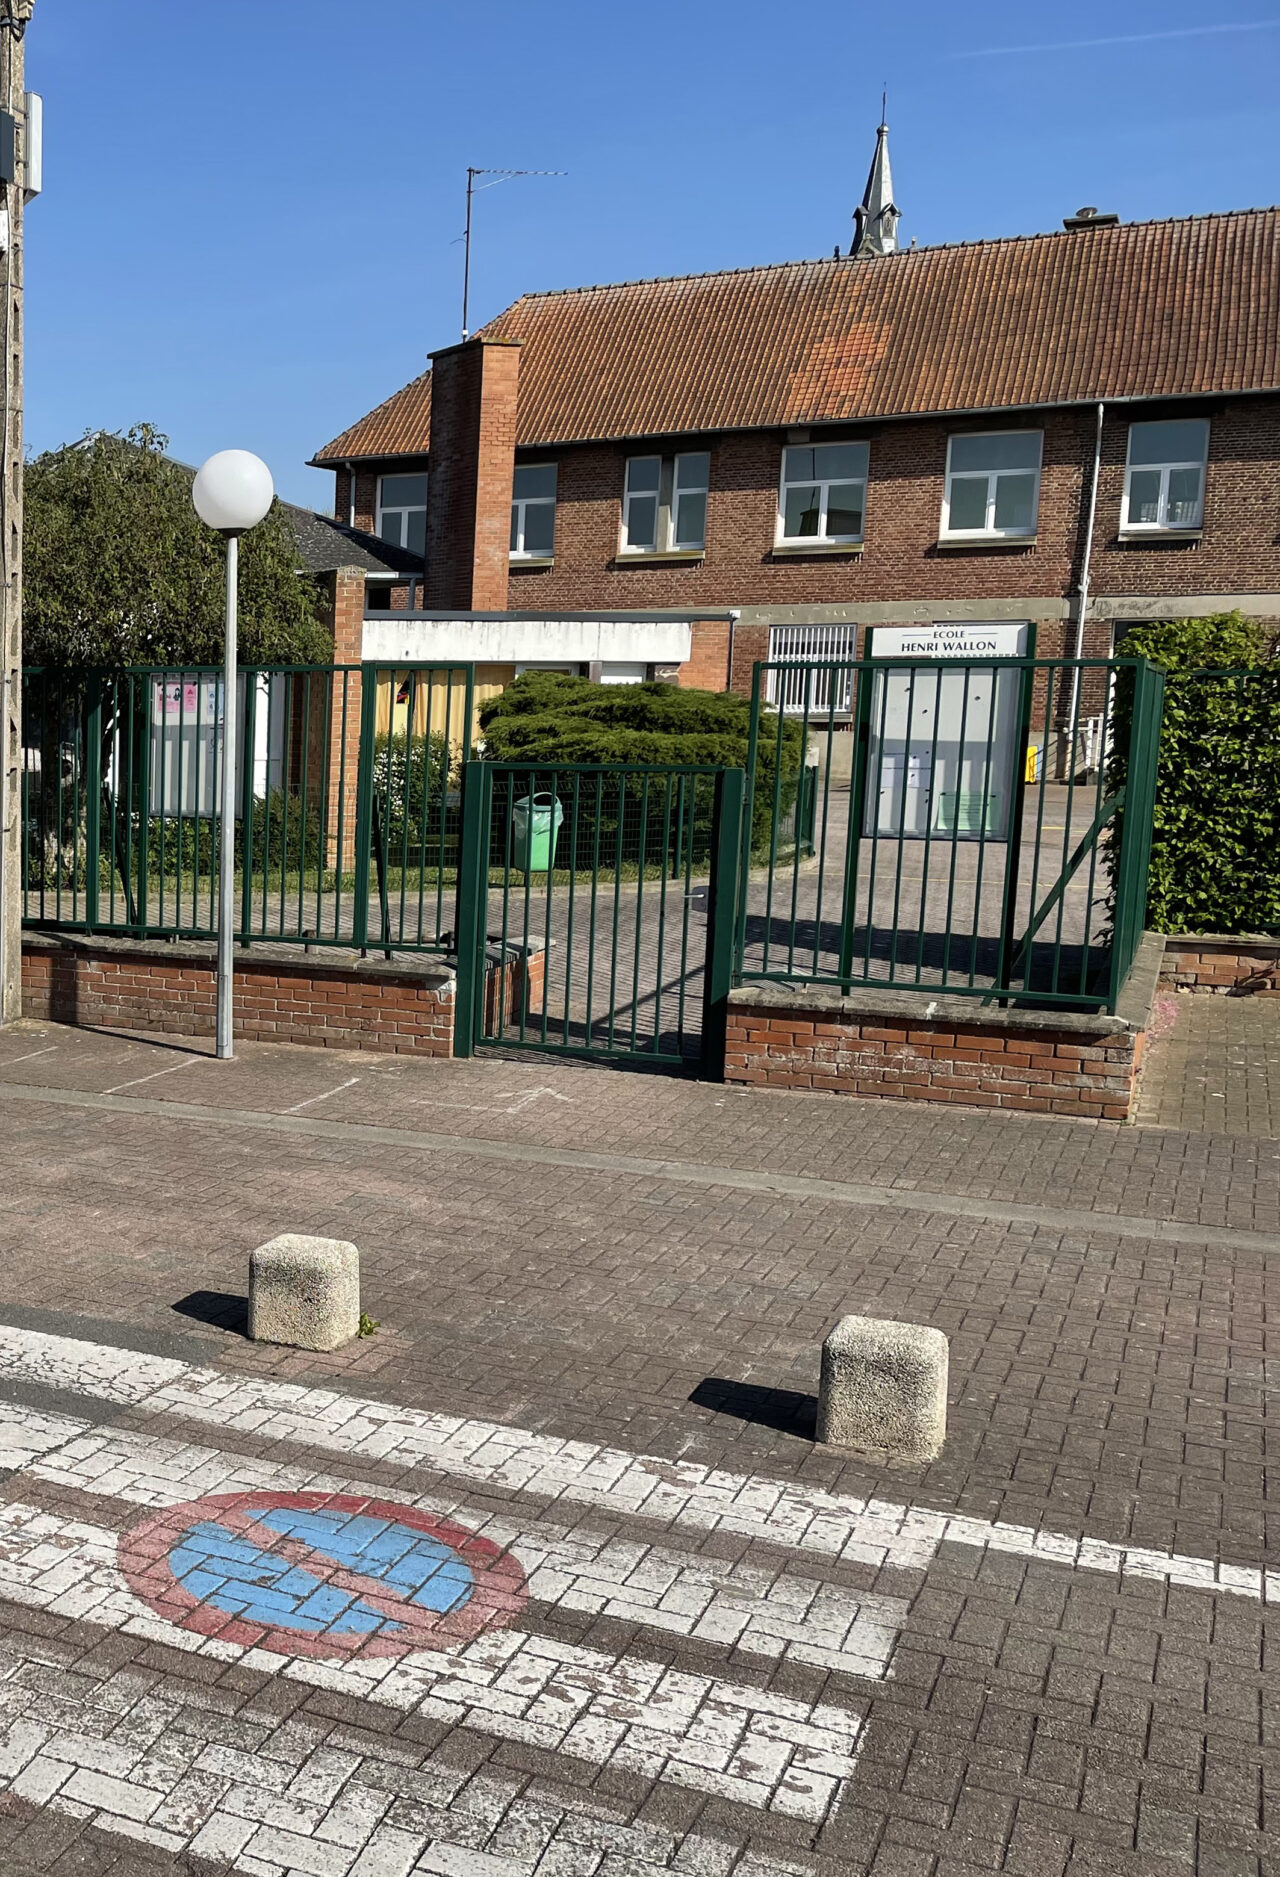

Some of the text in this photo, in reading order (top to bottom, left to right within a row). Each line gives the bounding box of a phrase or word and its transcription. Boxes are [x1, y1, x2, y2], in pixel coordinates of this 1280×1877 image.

[933, 630, 965, 639] ECOLE
[901, 641, 997, 652] HENRI WALLON
